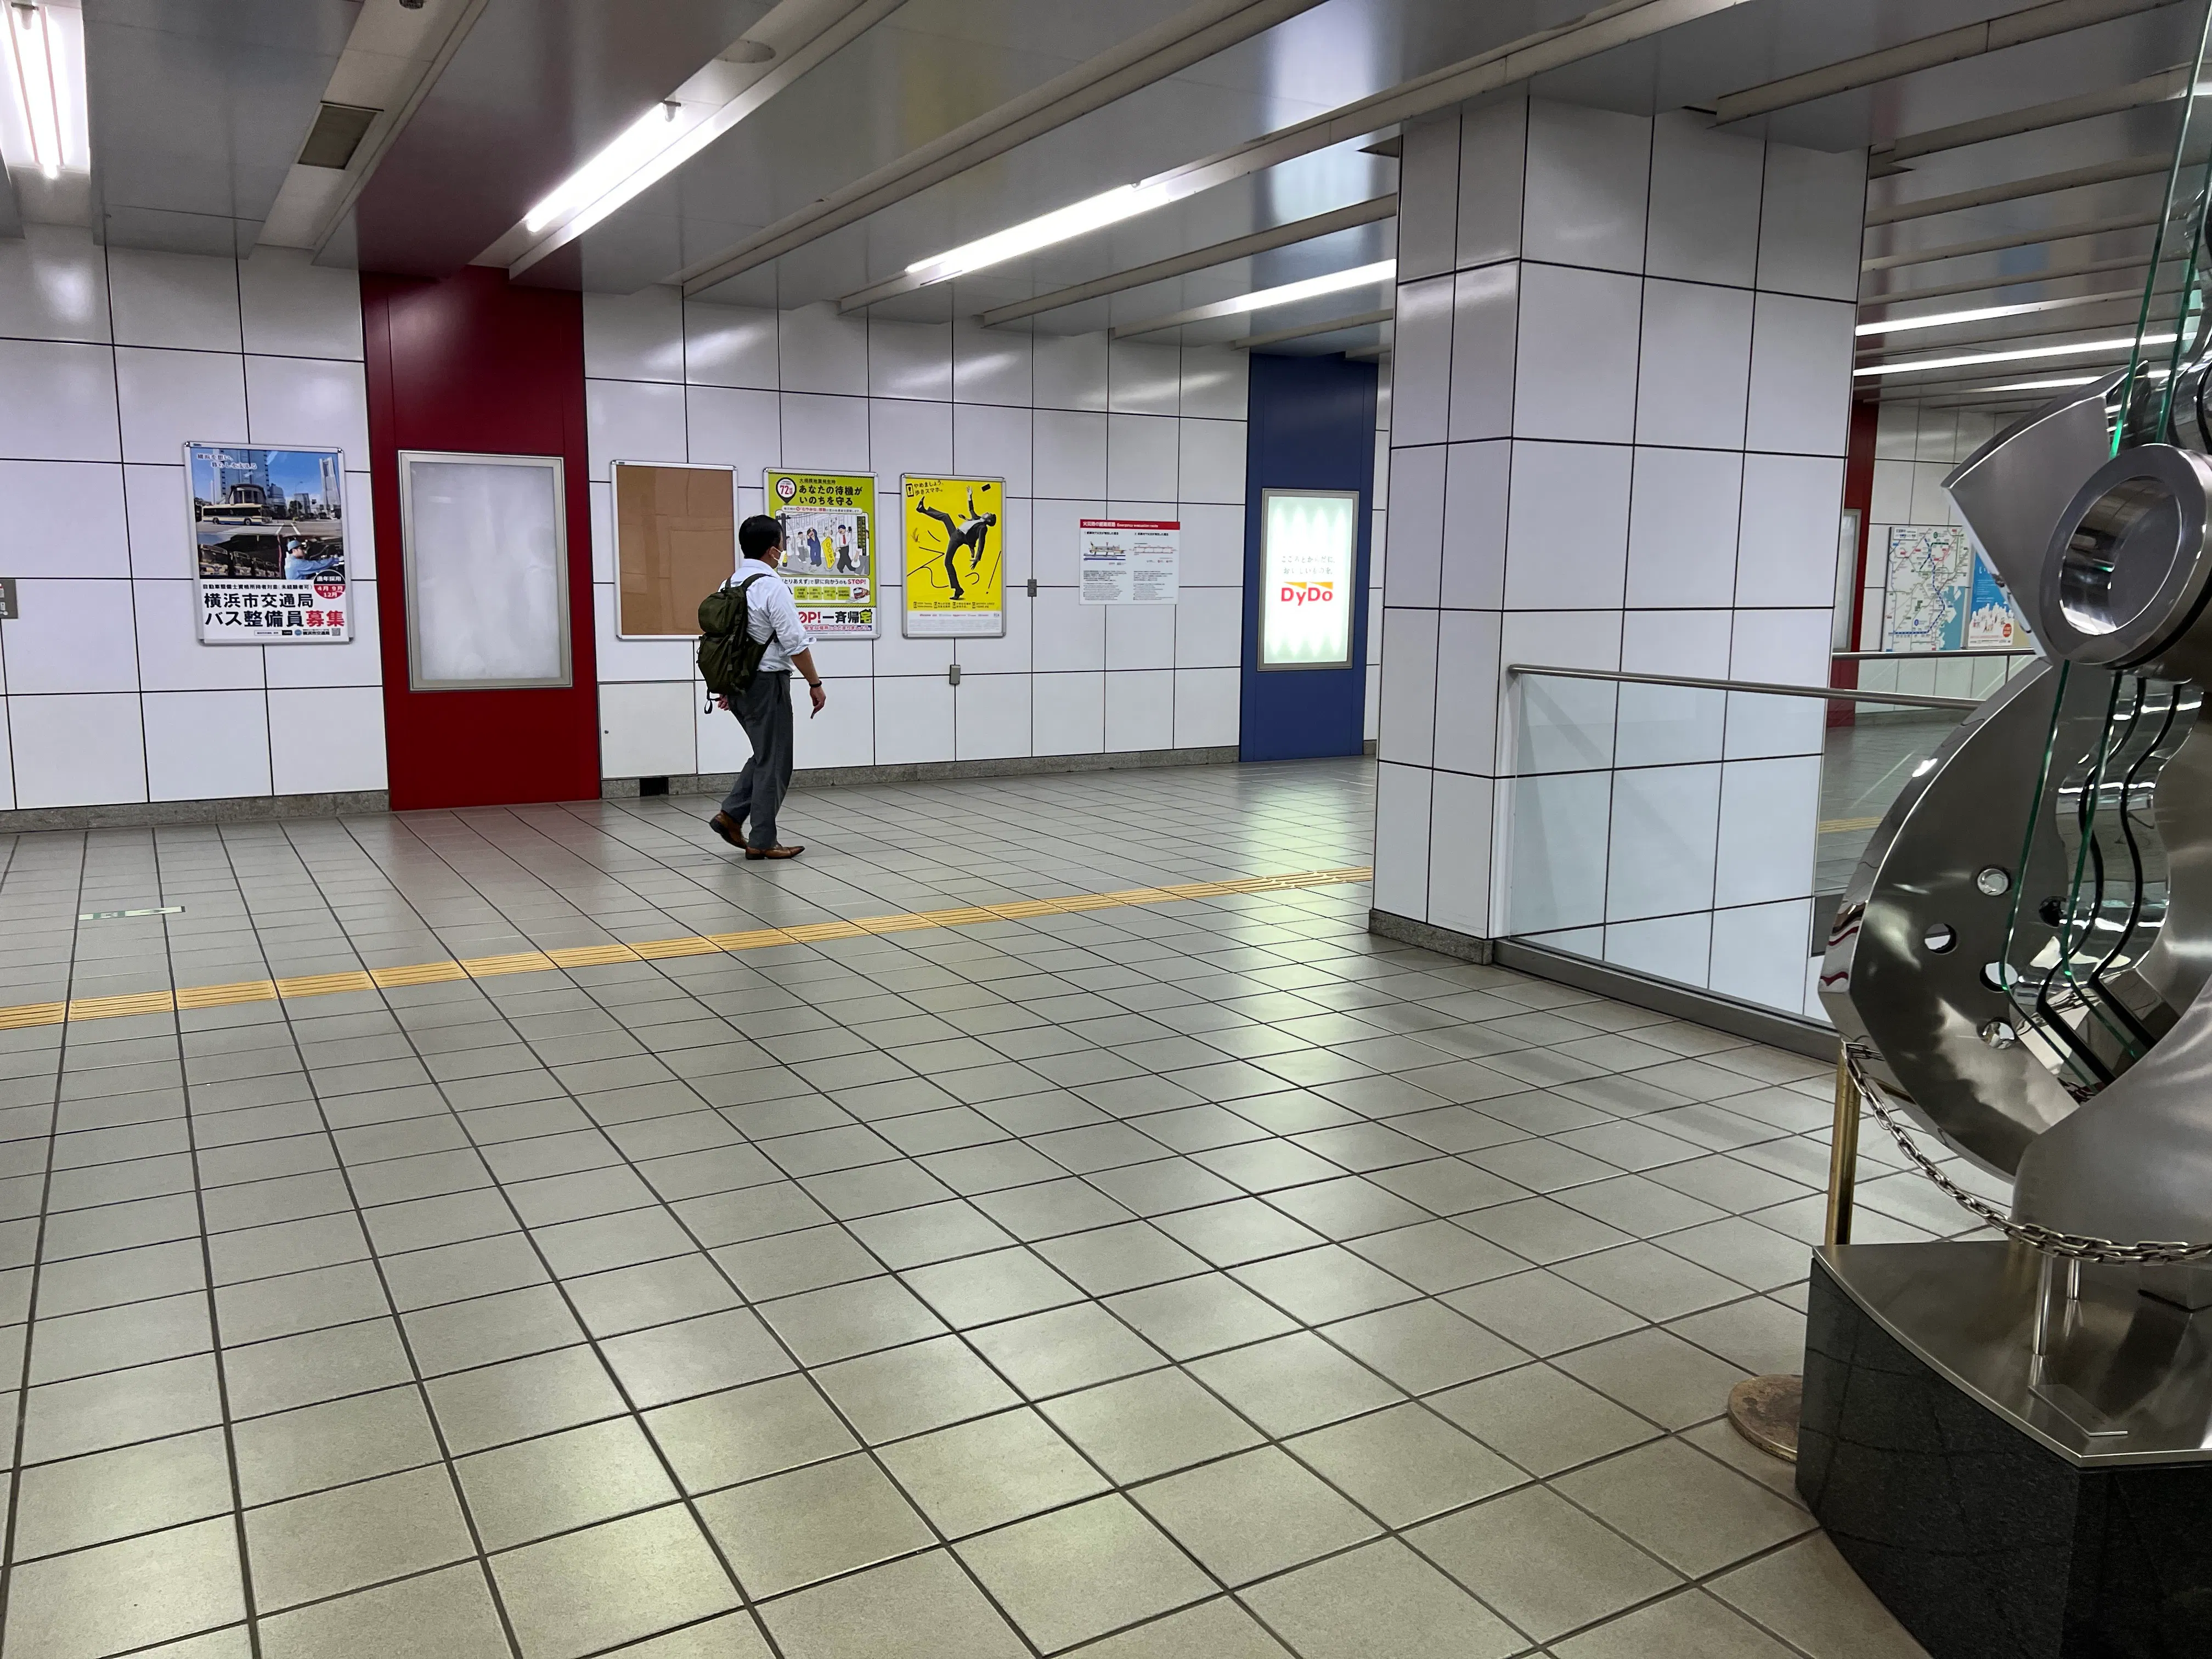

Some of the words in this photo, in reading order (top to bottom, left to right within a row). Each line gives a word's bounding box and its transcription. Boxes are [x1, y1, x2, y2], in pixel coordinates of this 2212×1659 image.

[799, 485, 863, 496] あなたの待機が
[800, 496, 853, 506] いのちを守る
[204, 593, 313, 608] 横浜市交通局
[1281, 588, 1333, 606] DyDo
[205, 610, 345, 627] バス整備員募集
